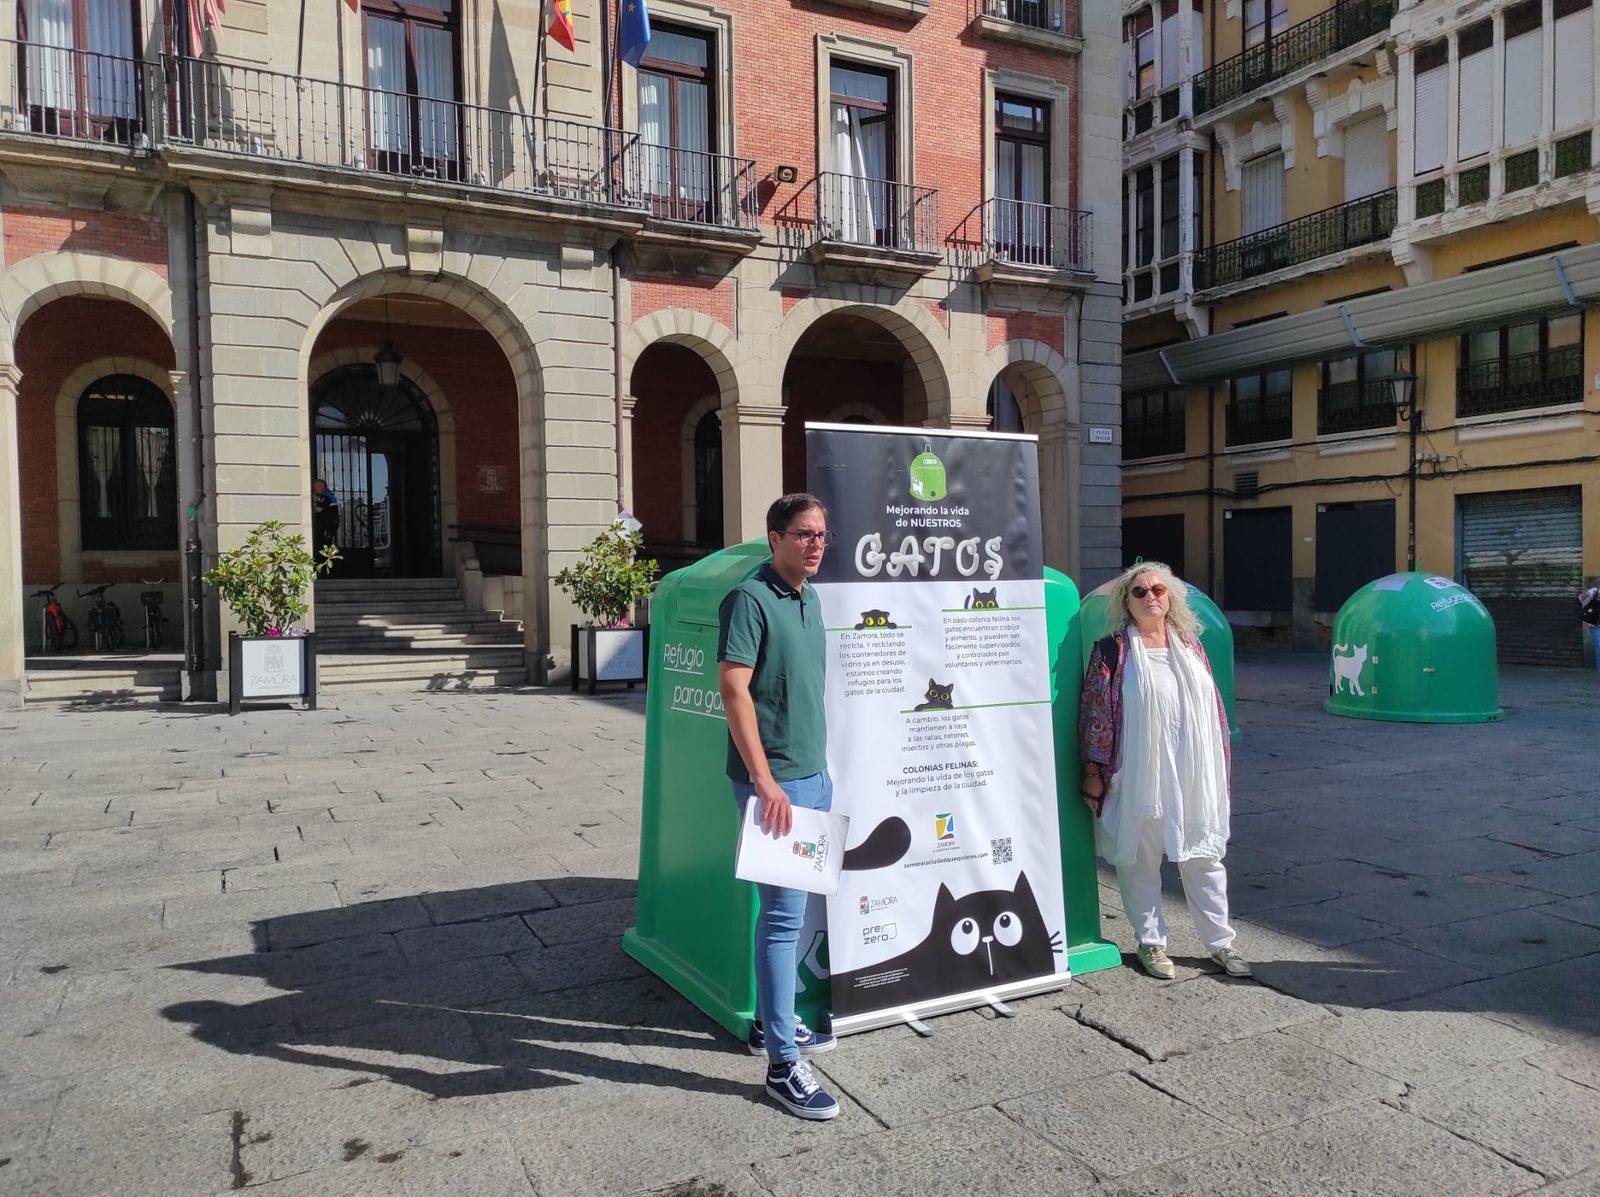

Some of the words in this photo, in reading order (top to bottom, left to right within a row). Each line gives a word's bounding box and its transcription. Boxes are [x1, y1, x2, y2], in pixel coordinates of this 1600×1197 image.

[887, 505, 938, 516] Mejorando
[941, 506, 948, 515] la
[950, 506, 969, 516] vida
[896, 519, 908, 528] de
[911, 519, 961, 528] NUESTROS
[855, 533, 1003, 580] GATOS
[979, 641, 1021, 649] supervisados
[664, 642, 704, 670] Refugio
[248, 674, 296, 685] ZAMORA
[848, 678, 875, 687] refugios
[673, 686, 702, 706] para
[844, 688, 864, 697] gatos
[903, 764, 943, 774] COLONIAS
[946, 761, 978, 770] FELINAS:
[887, 777, 925, 788] Mejorando
[909, 785, 941, 794] limpieza
[814, 834, 827, 872] ZAMORA
[904, 852, 988, 868] zamoralaciudadquequieres.com
[870, 896, 897, 908] ZAMORA
[863, 926, 880, 936] pre
[864, 934, 888, 945] zero
